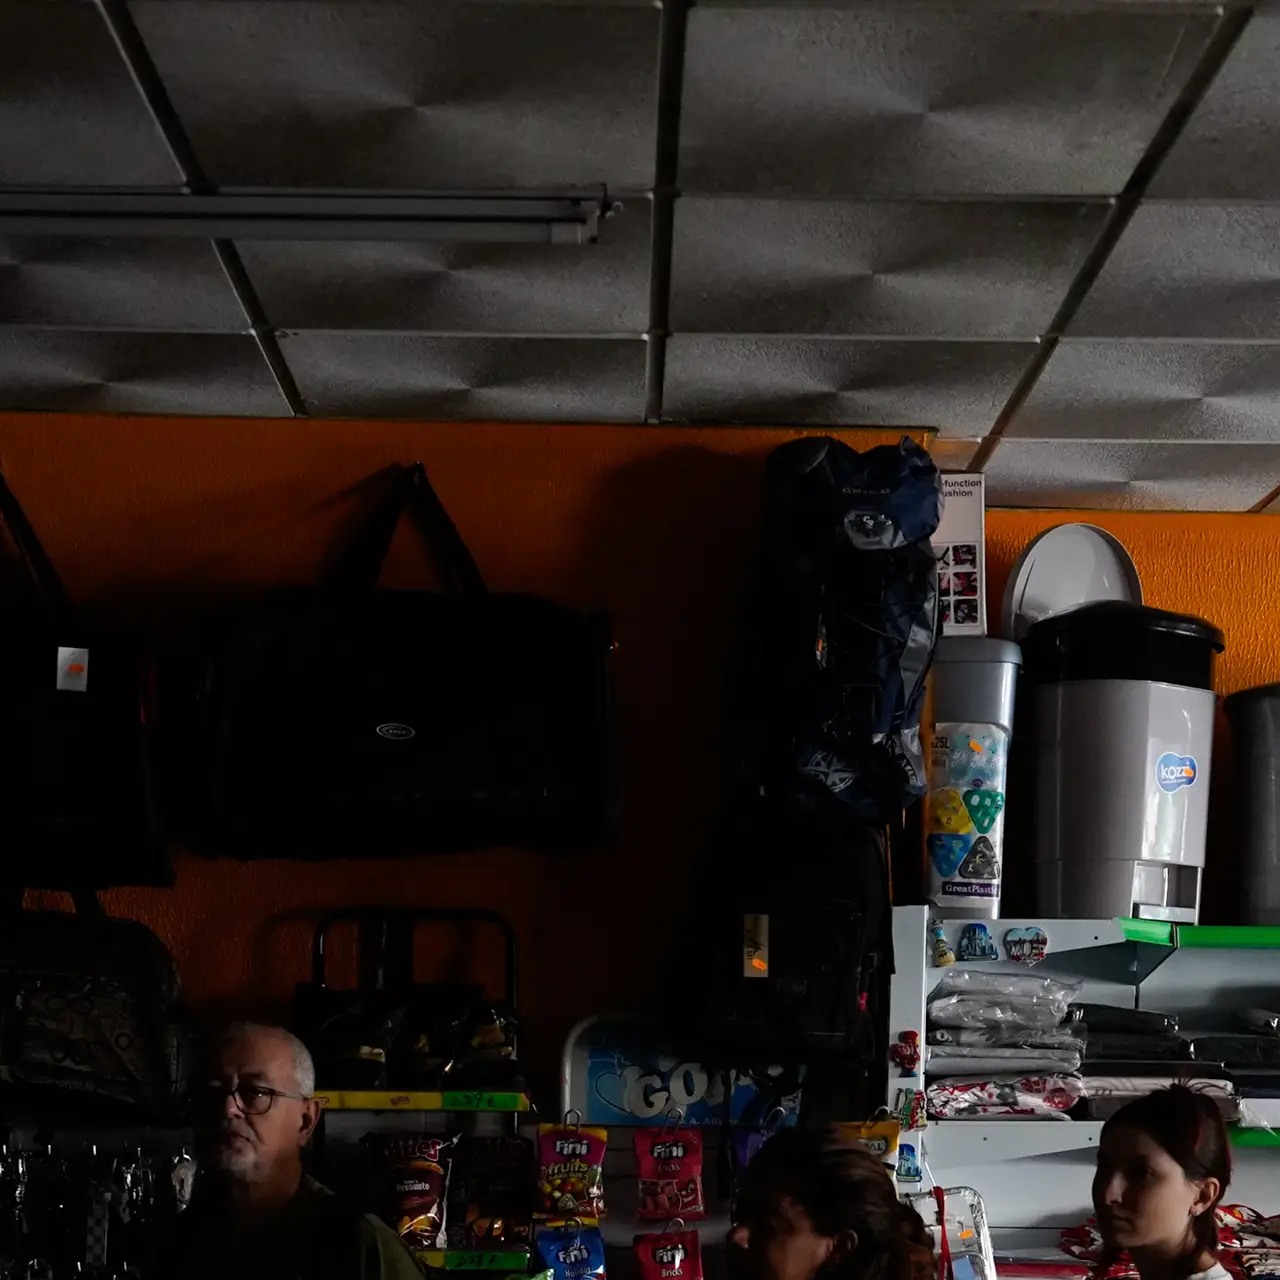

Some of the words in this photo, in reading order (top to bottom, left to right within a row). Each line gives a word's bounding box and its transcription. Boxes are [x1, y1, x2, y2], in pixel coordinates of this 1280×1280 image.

[555, 1139, 589, 1156] Fini
[651, 1143, 685, 1159] Fini
[558, 1244, 590, 1264] Fini
[661, 1267, 684, 1277] Bricks
